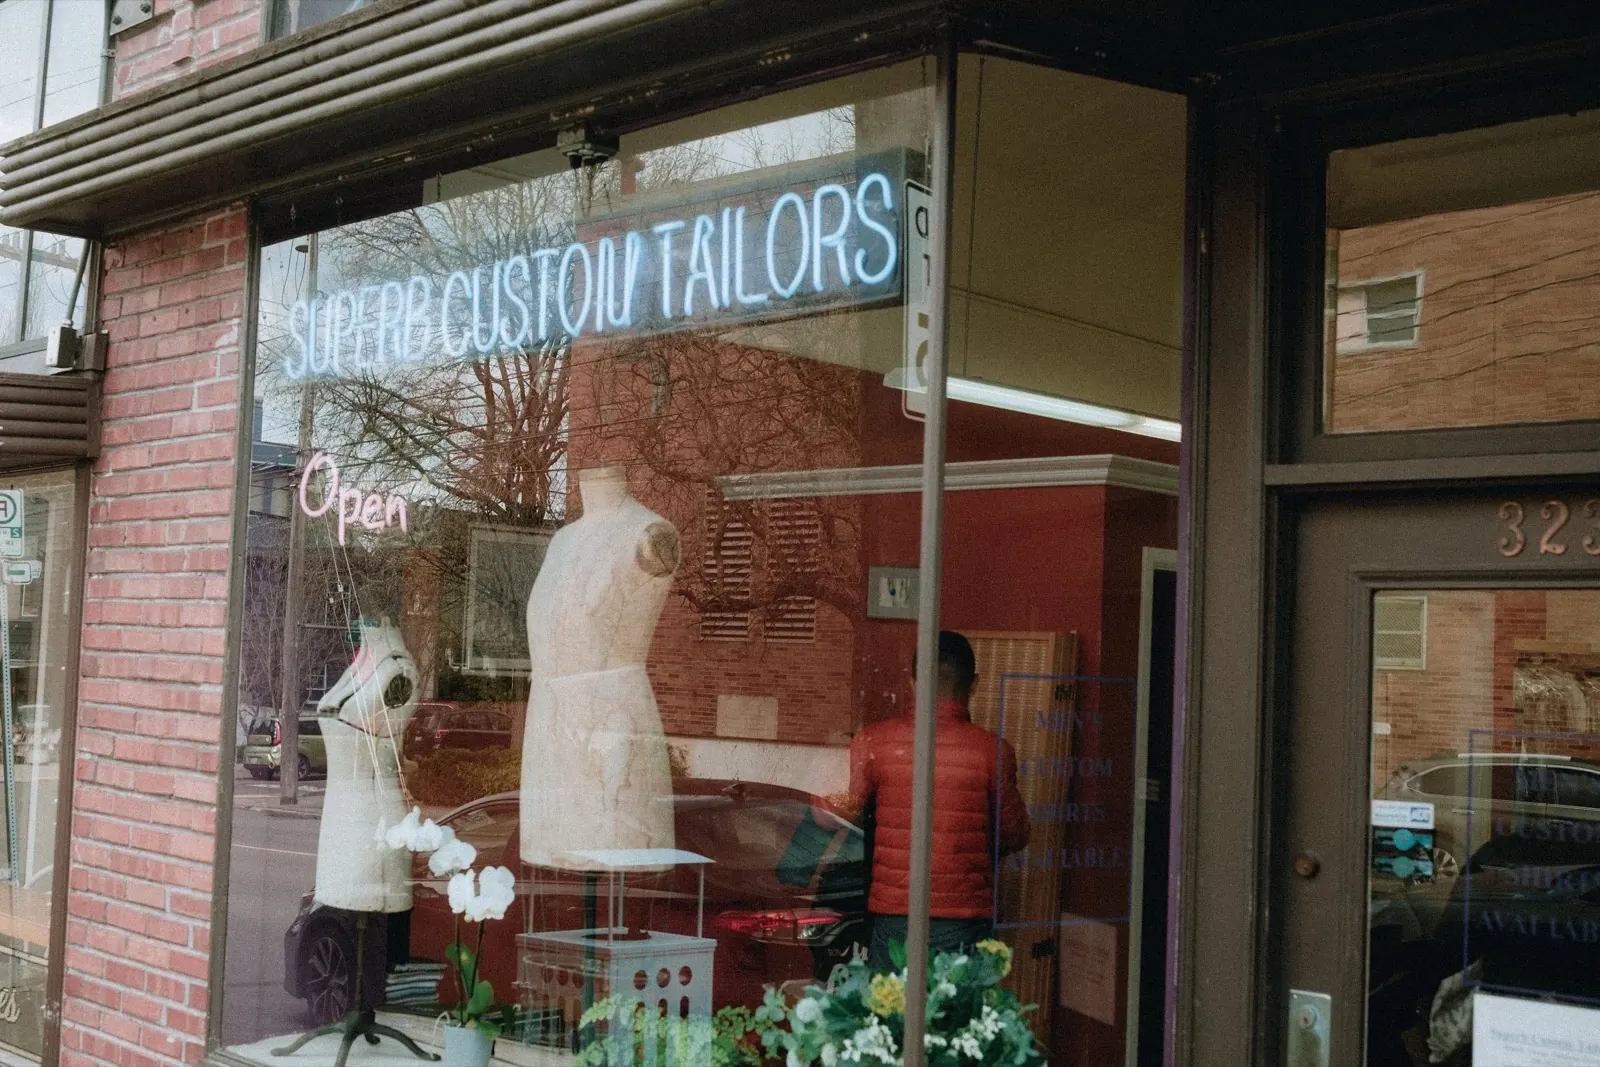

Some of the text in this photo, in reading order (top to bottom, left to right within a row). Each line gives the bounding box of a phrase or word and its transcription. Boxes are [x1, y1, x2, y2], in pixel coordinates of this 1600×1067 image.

[285, 273, 431, 379] SUPERB
[441, 231, 643, 358] CUSTOM
[653, 172, 898, 319] TAILORS
[299, 451, 407, 546] Open
